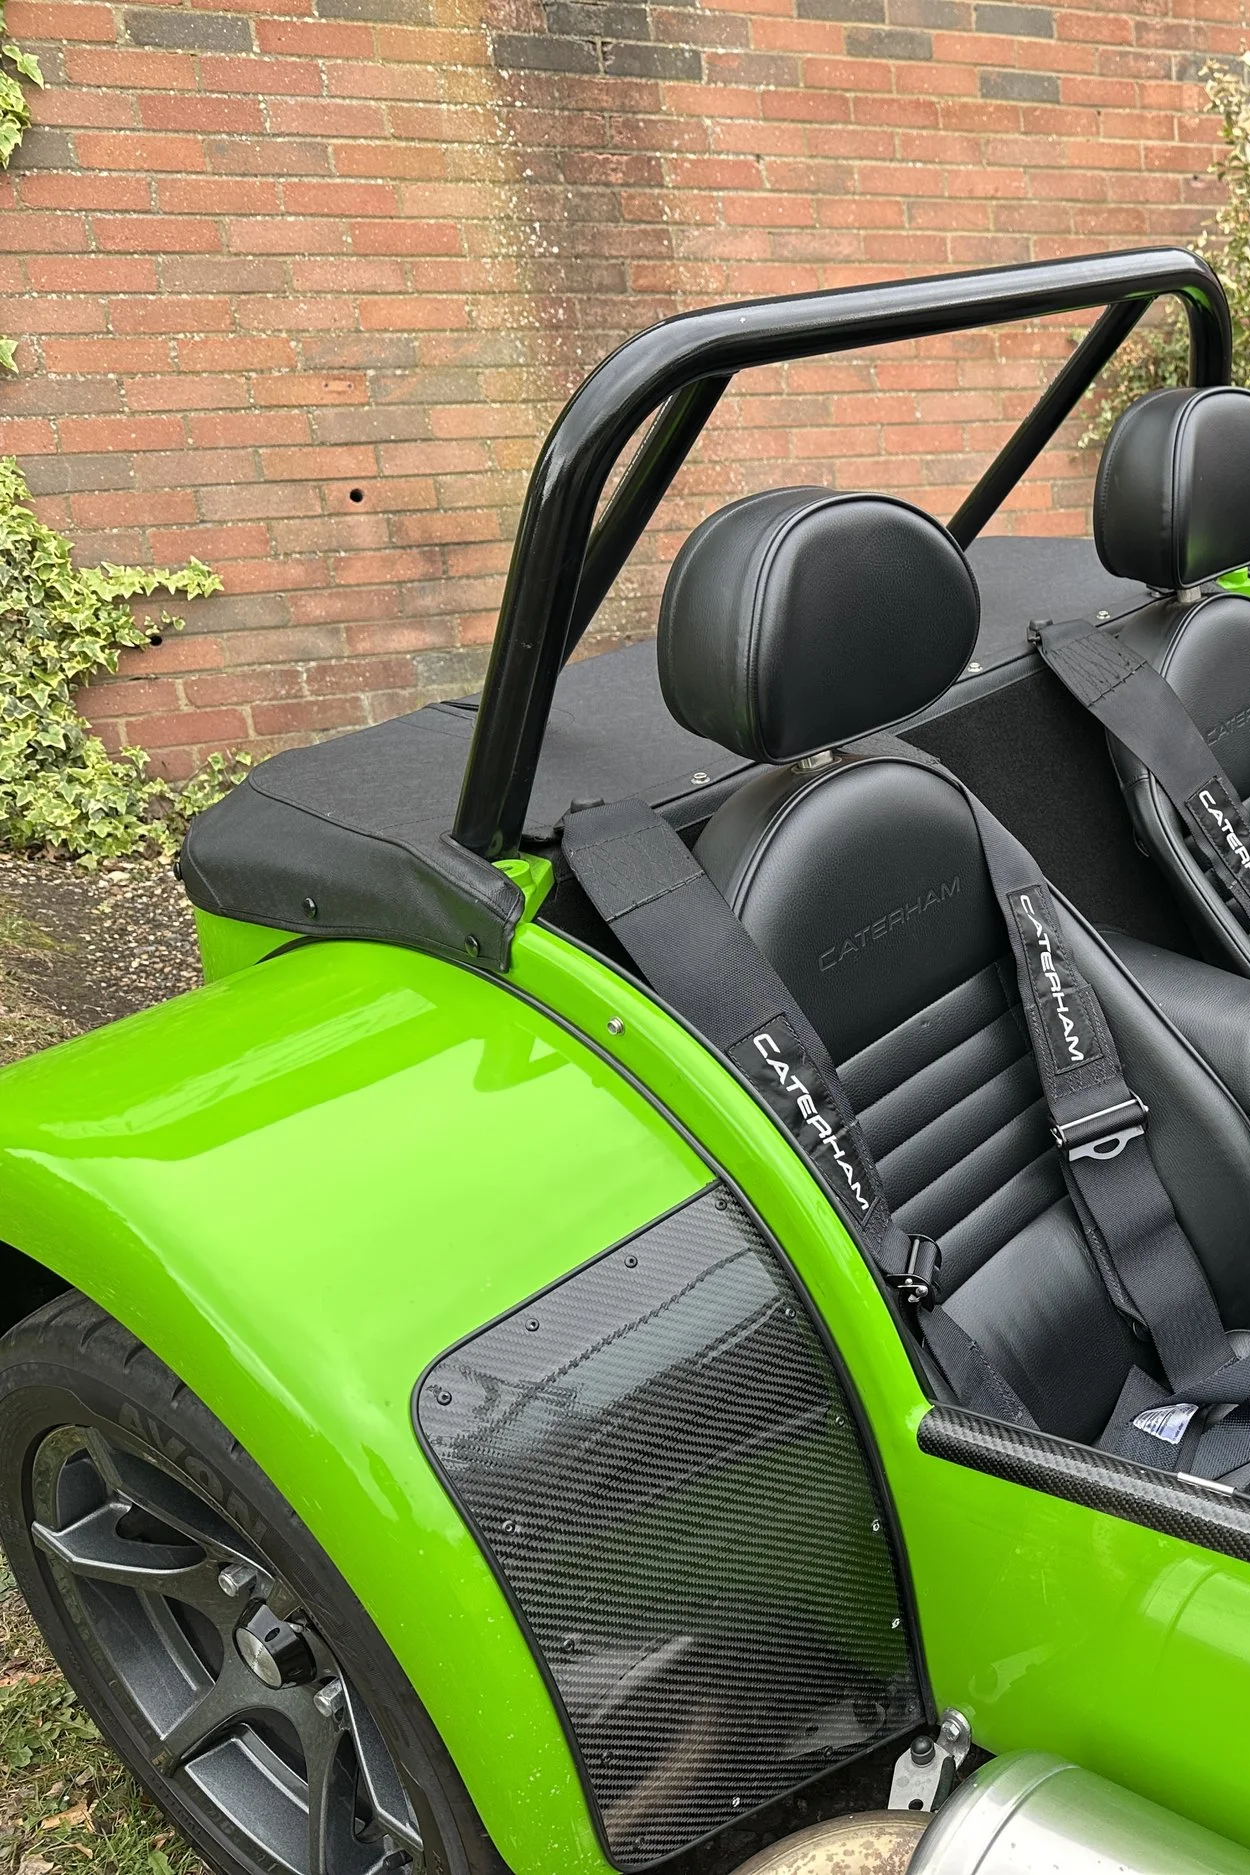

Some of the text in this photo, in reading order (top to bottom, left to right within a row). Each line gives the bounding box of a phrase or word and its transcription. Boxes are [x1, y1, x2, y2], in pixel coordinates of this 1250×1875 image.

[818, 876, 962, 973] CATERHAM
[1020, 894, 1084, 1061] CATERHAM
[752, 1032, 870, 1211] CATERHAM
